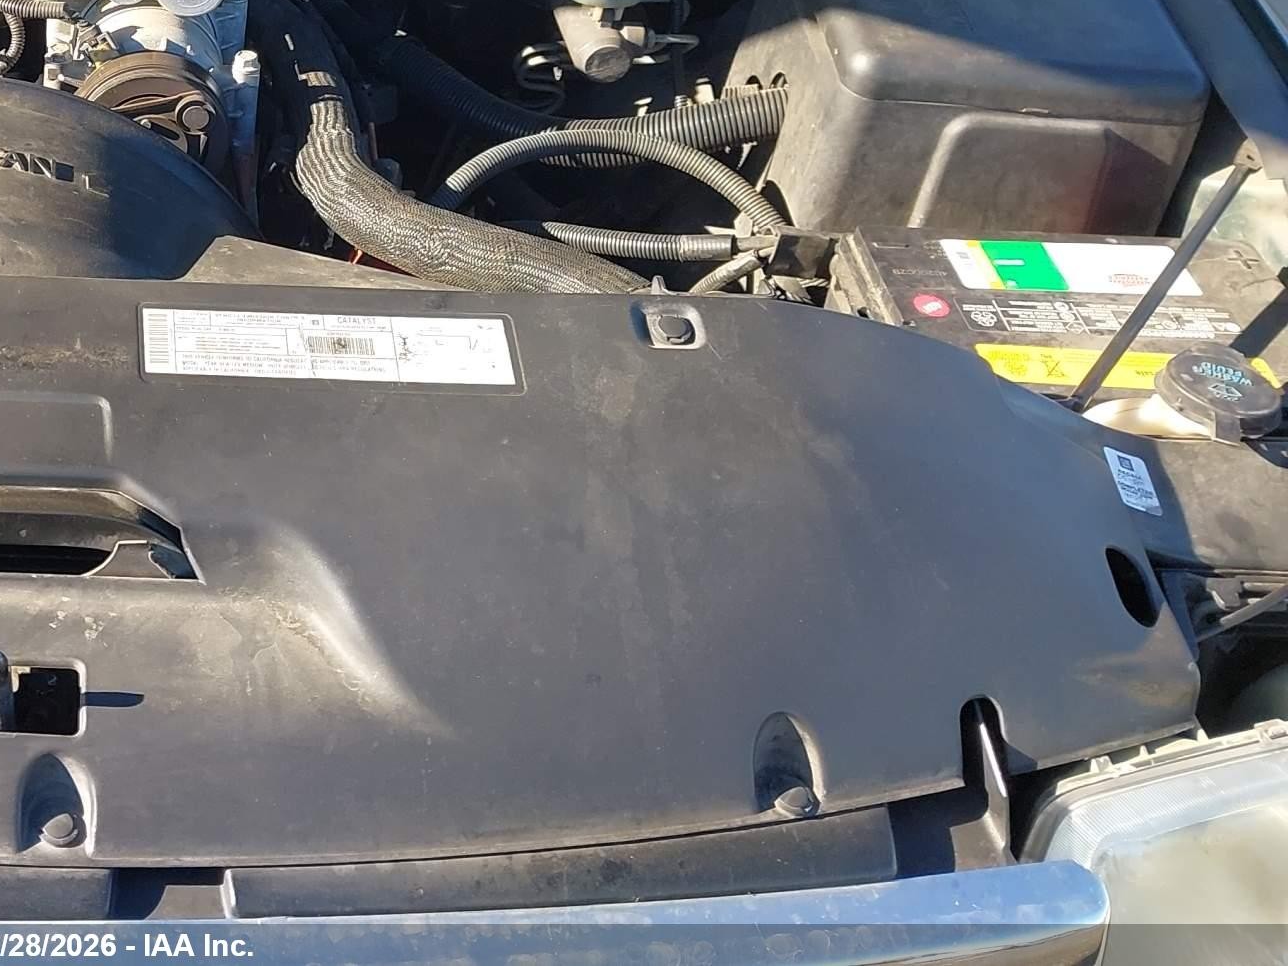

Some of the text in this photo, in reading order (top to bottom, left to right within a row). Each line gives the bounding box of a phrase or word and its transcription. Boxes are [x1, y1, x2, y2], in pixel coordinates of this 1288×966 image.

[336, 316, 377, 326] CATALYST
[1192, 365, 1253, 386] WASHER
[1200, 361, 1242, 378] FLUID
